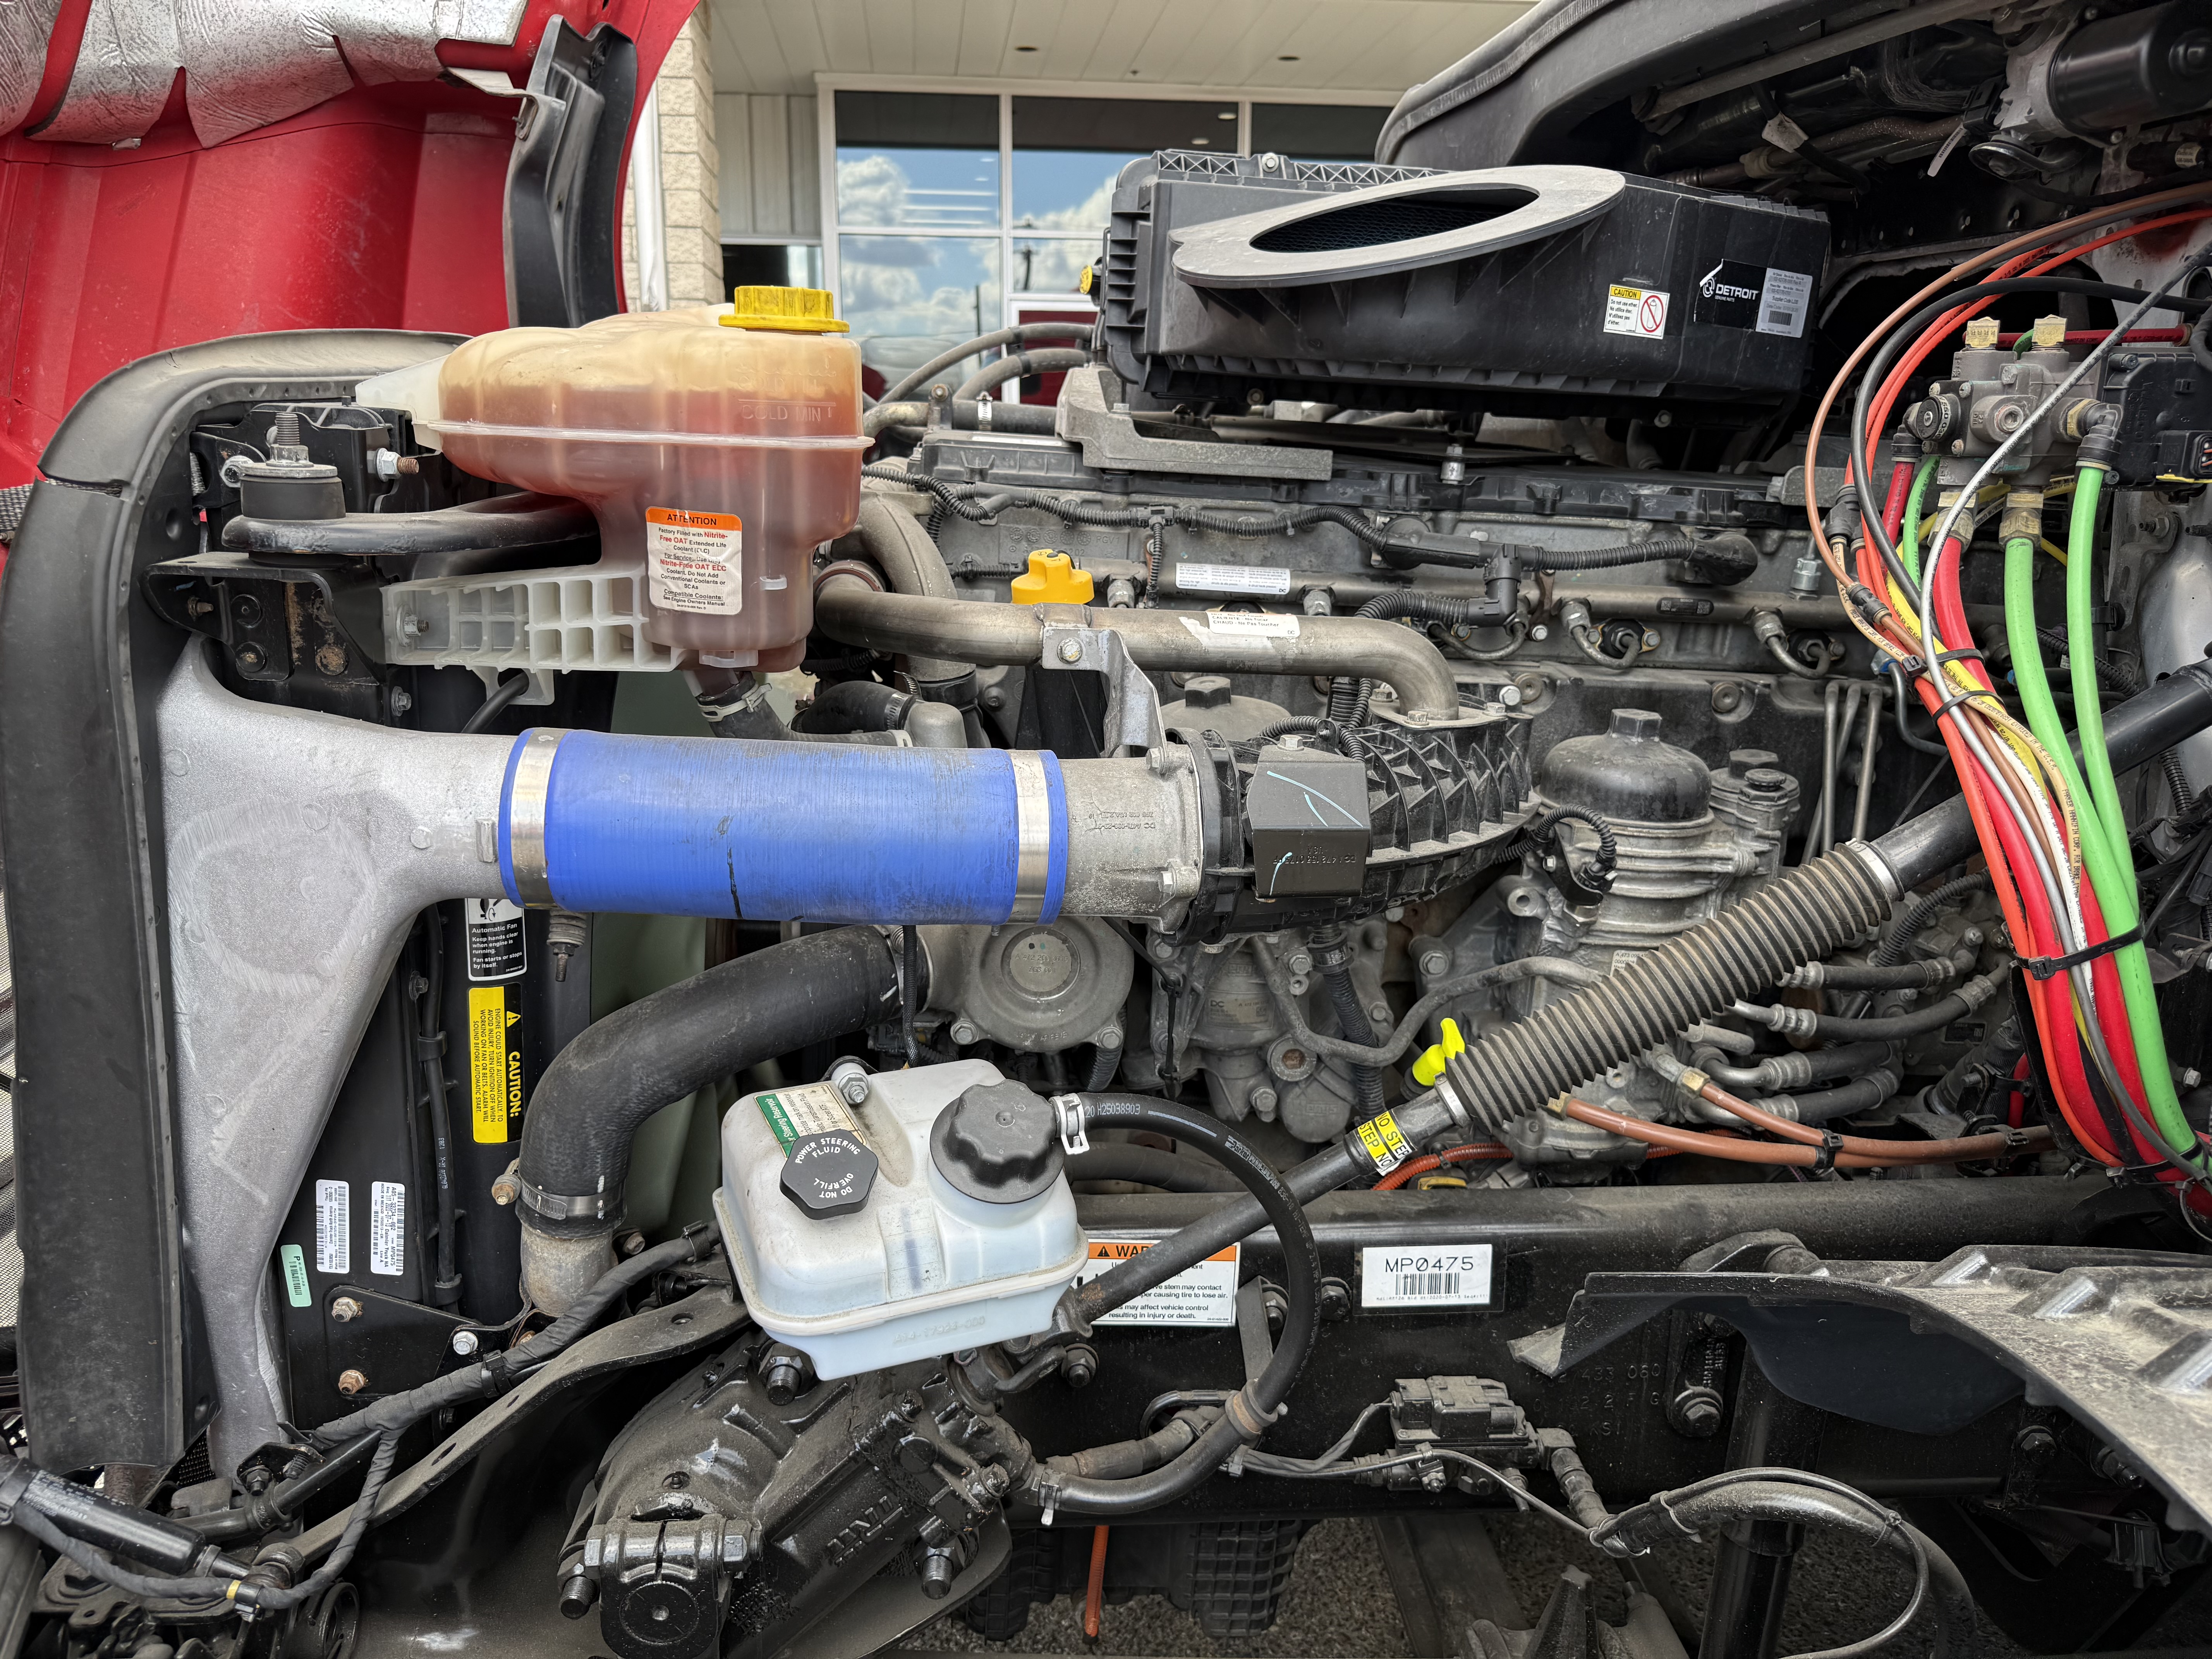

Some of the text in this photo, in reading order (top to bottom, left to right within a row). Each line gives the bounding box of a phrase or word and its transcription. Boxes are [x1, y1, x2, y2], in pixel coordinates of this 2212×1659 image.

[1614, 289, 1637, 298] CAUTION
[1716, 284, 1760, 300] DETROIT
[742, 404, 821, 422] COLD MIN
[667, 514, 716, 525] ATTENTION
[660, 559, 693, 569] Nitrite-Free
[661, 574, 692, 582] Conventional
[664, 589, 693, 598] Compatible
[2011, 718, 2057, 770] EXTRUDED IN THE U.S.A.
[2062, 789, 2074, 808] PARKER
[2068, 809, 2079, 835] HANNIFIN
[472, 925, 505, 933] Automatic
[481, 1039, 487, 1048] ON
[482, 1063, 487, 1071] OR
[508, 1051, 522, 1117] CAUTION:
[763, 1097, 783, 1118] Reservoir
[797, 1093, 821, 1122] Transmission Fluid
[823, 1109, 837, 1120] Super
[1097, 1102, 1140, 1115] H25038903
[775, 1118, 796, 1137] Steering
[1375, 1113, 1410, 1156] NO STEP
[795, 1137, 860, 1164] POWER STEERING
[812, 1146, 841, 1158] FLUID
[1360, 1122, 1392, 1167] STEP NO
[814, 1173, 854, 1190] OVERFILL
[1224, 1135, 1252, 1161] Parker
[1293, 1209, 1309, 1238] HI-TEMP
[841, 1186, 853, 1196] DO
[1386, 1256, 1474, 1273] MP0475
